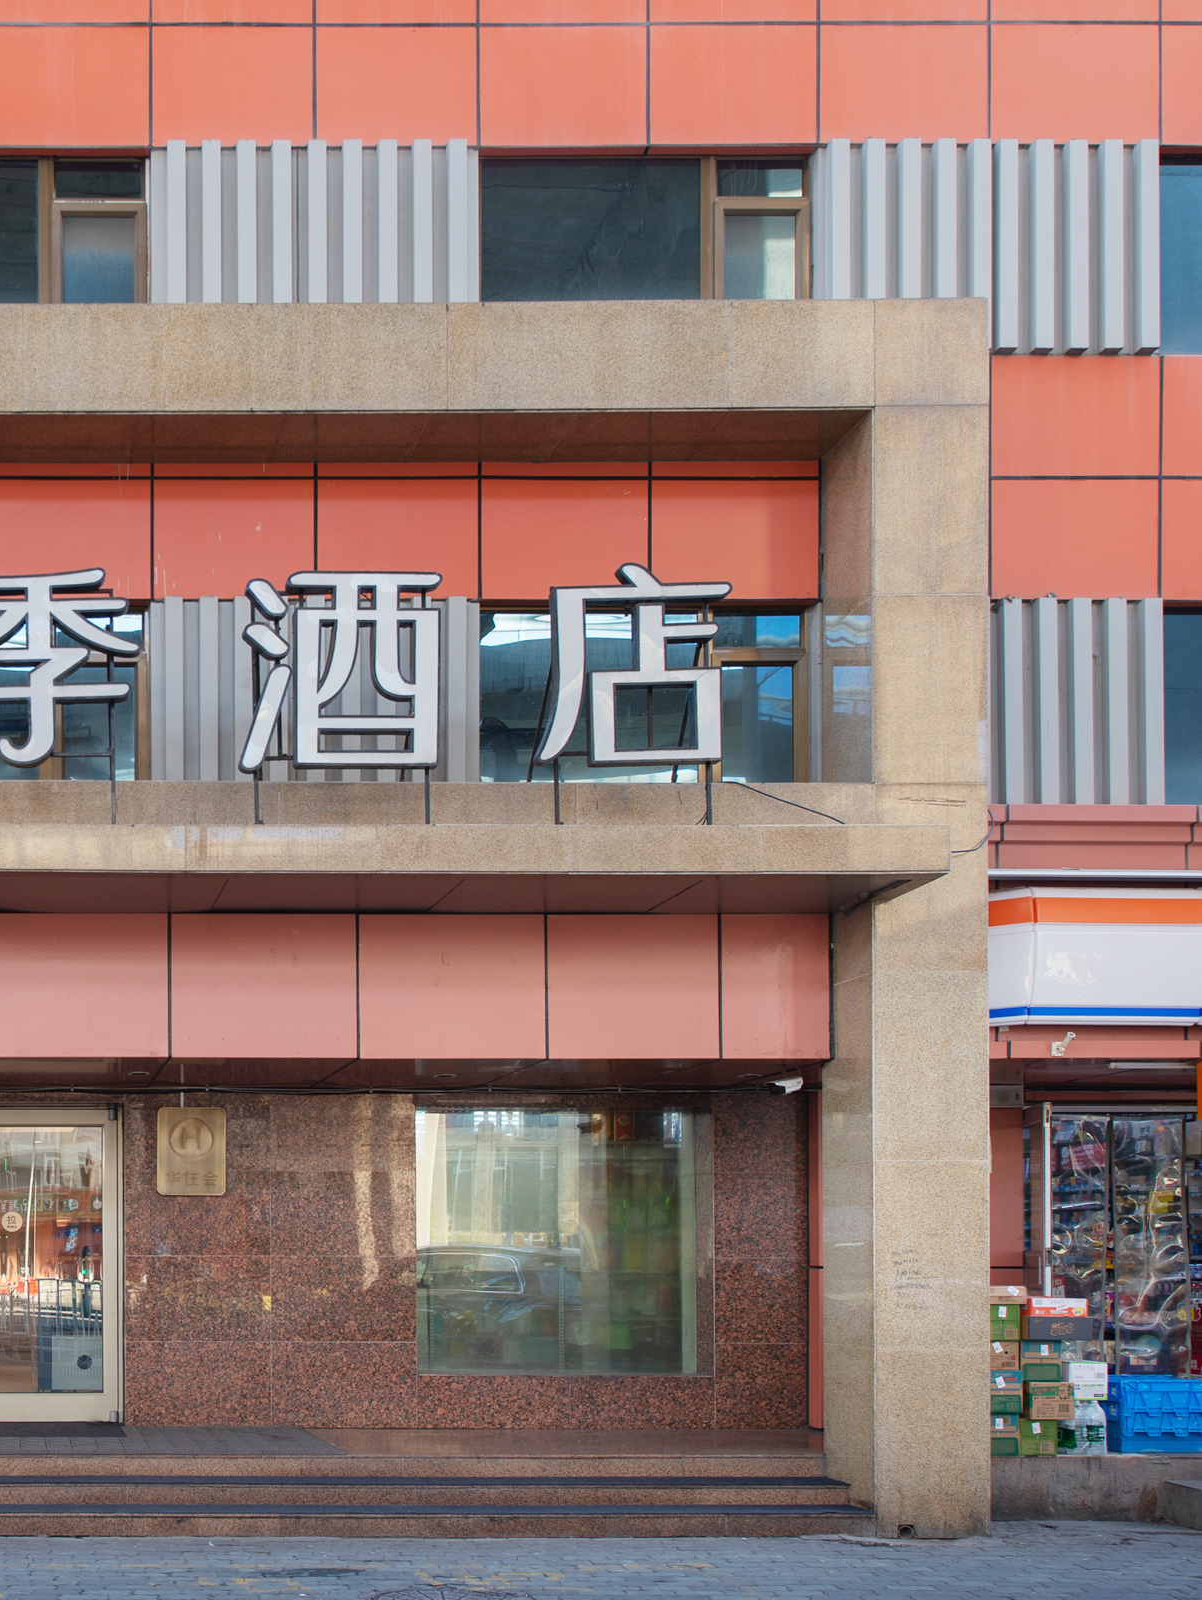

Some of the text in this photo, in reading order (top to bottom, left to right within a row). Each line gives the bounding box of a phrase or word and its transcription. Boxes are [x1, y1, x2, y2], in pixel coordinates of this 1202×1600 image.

[181, 1127, 201, 1150] H
[165, 1170, 218, 1187] 华住会
[7, 1215, 17, 1224] 拉
